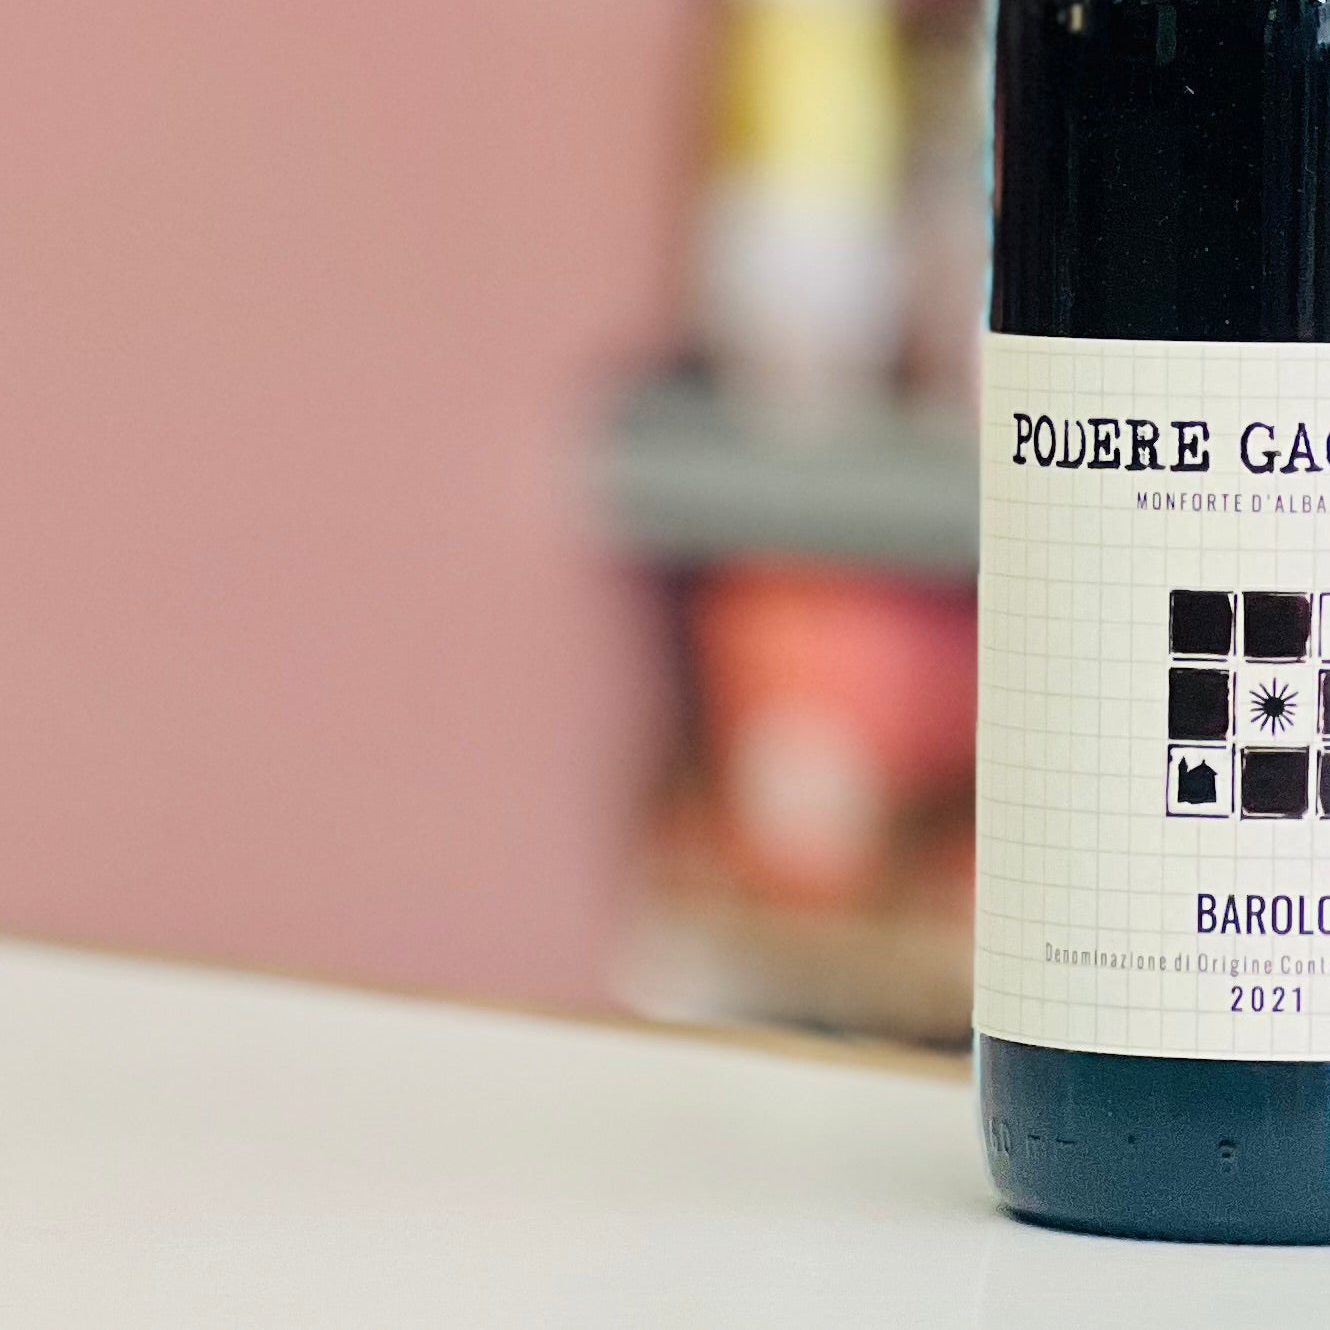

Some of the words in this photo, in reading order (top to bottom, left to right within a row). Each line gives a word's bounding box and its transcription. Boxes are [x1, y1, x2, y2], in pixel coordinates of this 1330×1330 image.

[1012, 413, 1210, 472] PODERE
[1136, 491, 1242, 512] MONFORTE
[1252, 493, 1327, 514] D'ALBA
[1045, 941, 1167, 972] Denominazione
[1174, 951, 1190, 972] di
[1198, 952, 1273, 978] Origine
[1230, 985, 1302, 1013] 2021
